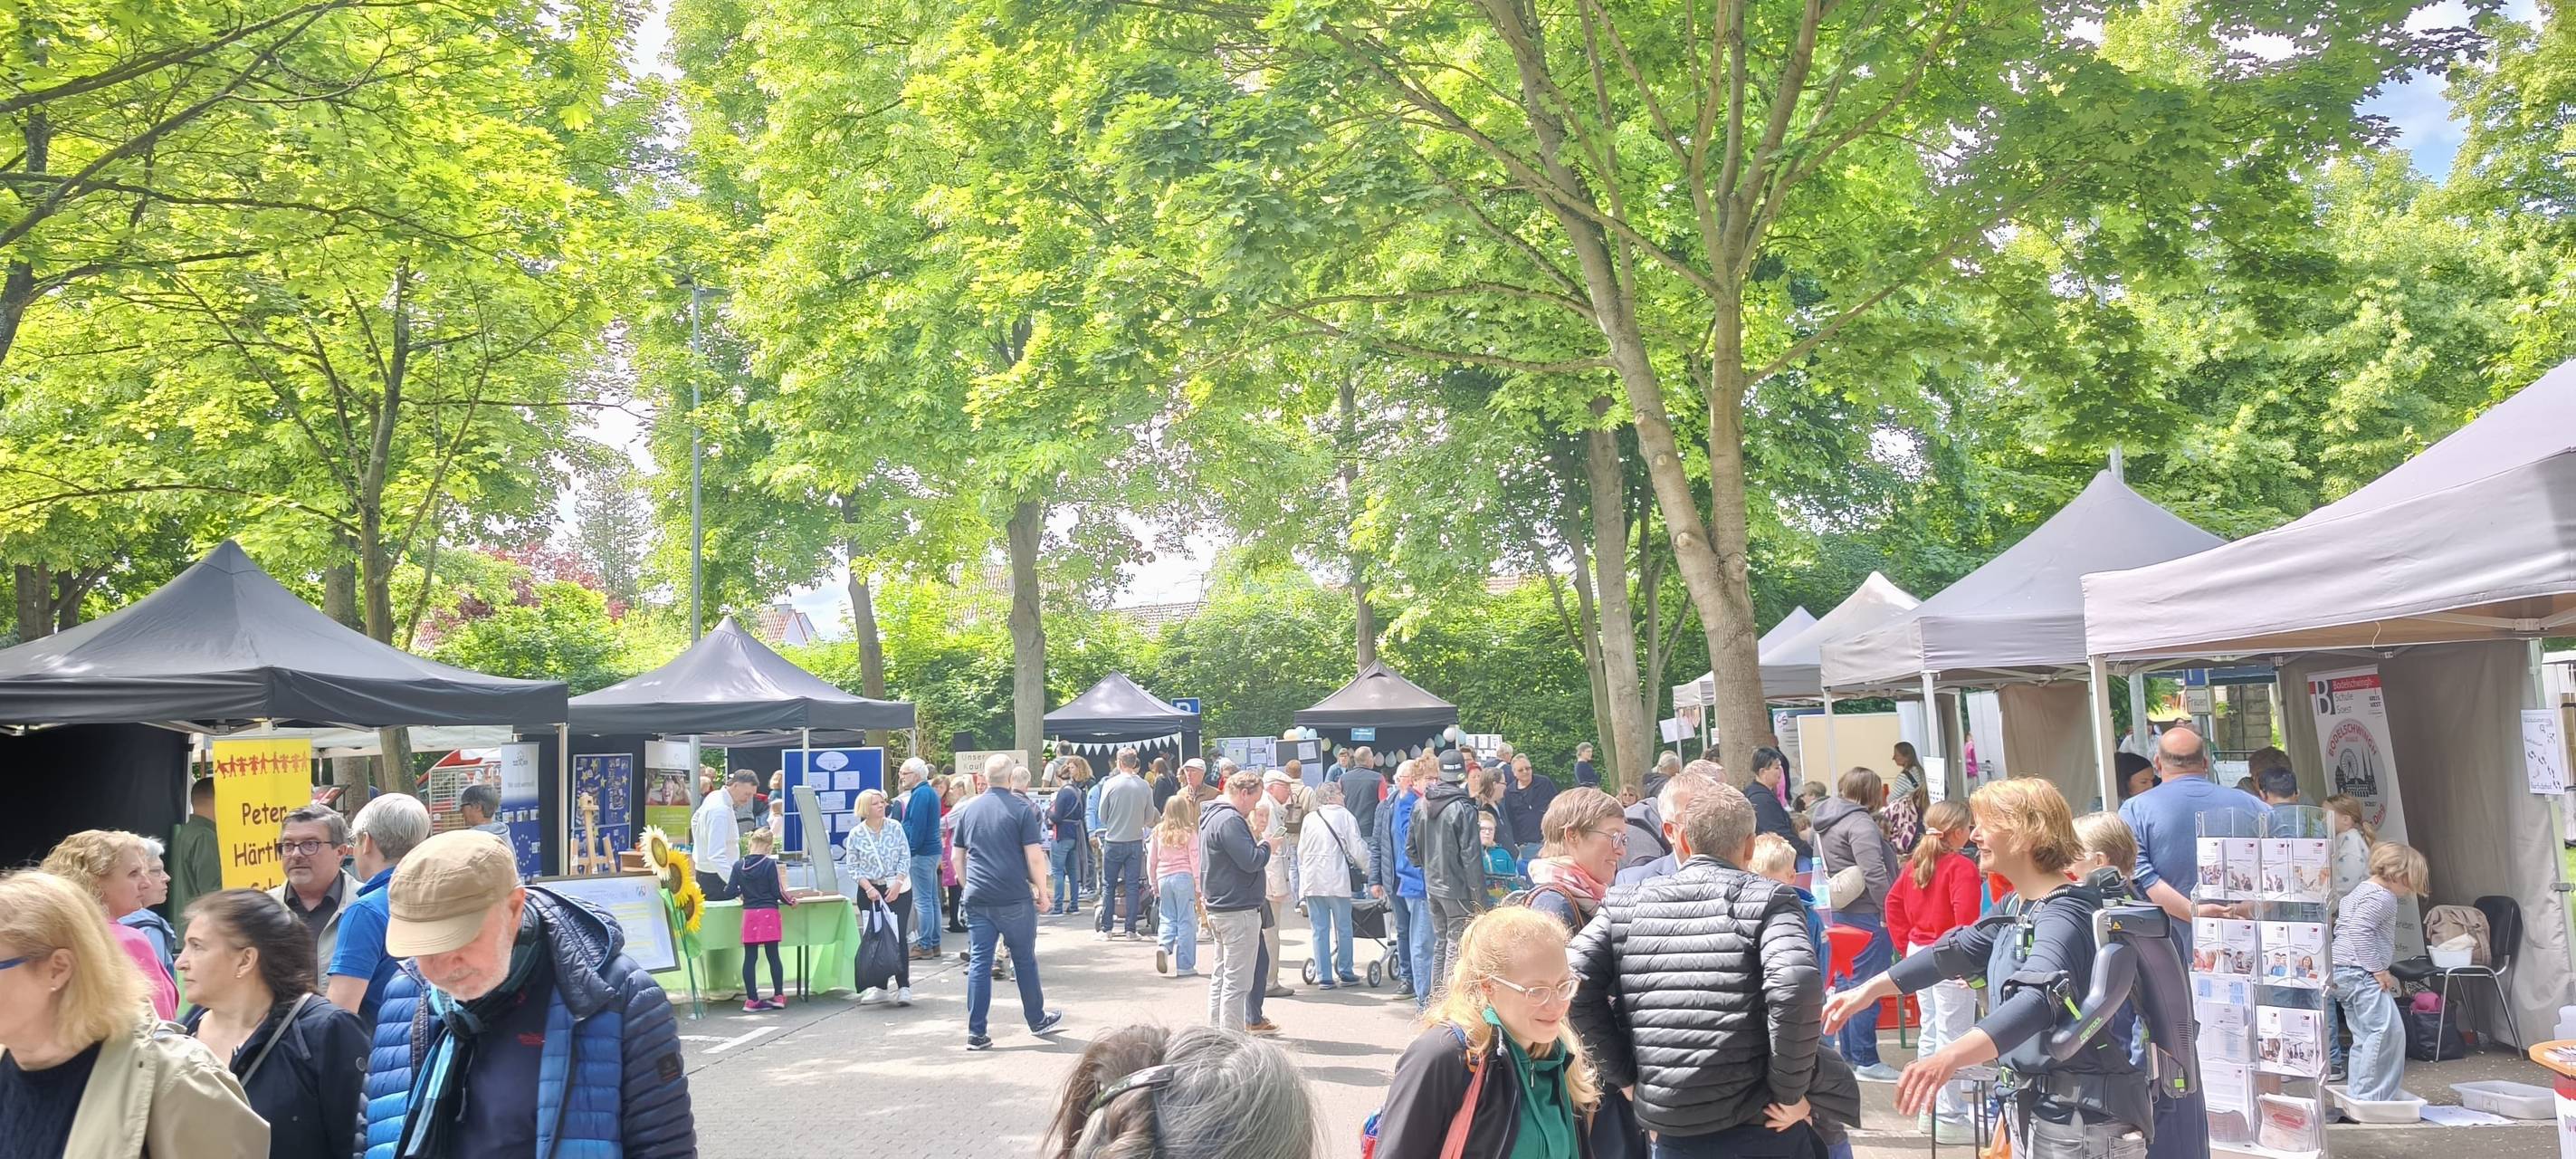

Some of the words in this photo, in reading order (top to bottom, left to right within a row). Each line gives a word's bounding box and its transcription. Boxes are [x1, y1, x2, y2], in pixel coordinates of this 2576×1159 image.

[2315, 680, 2333, 715] B
[2334, 692, 2354, 702] Schule
[2336, 705, 2352, 714] Soest
[2328, 723, 2377, 757] BODELSCHWINGH
[961, 753, 986, 761] Unser
[242, 802, 288, 826] Peter
